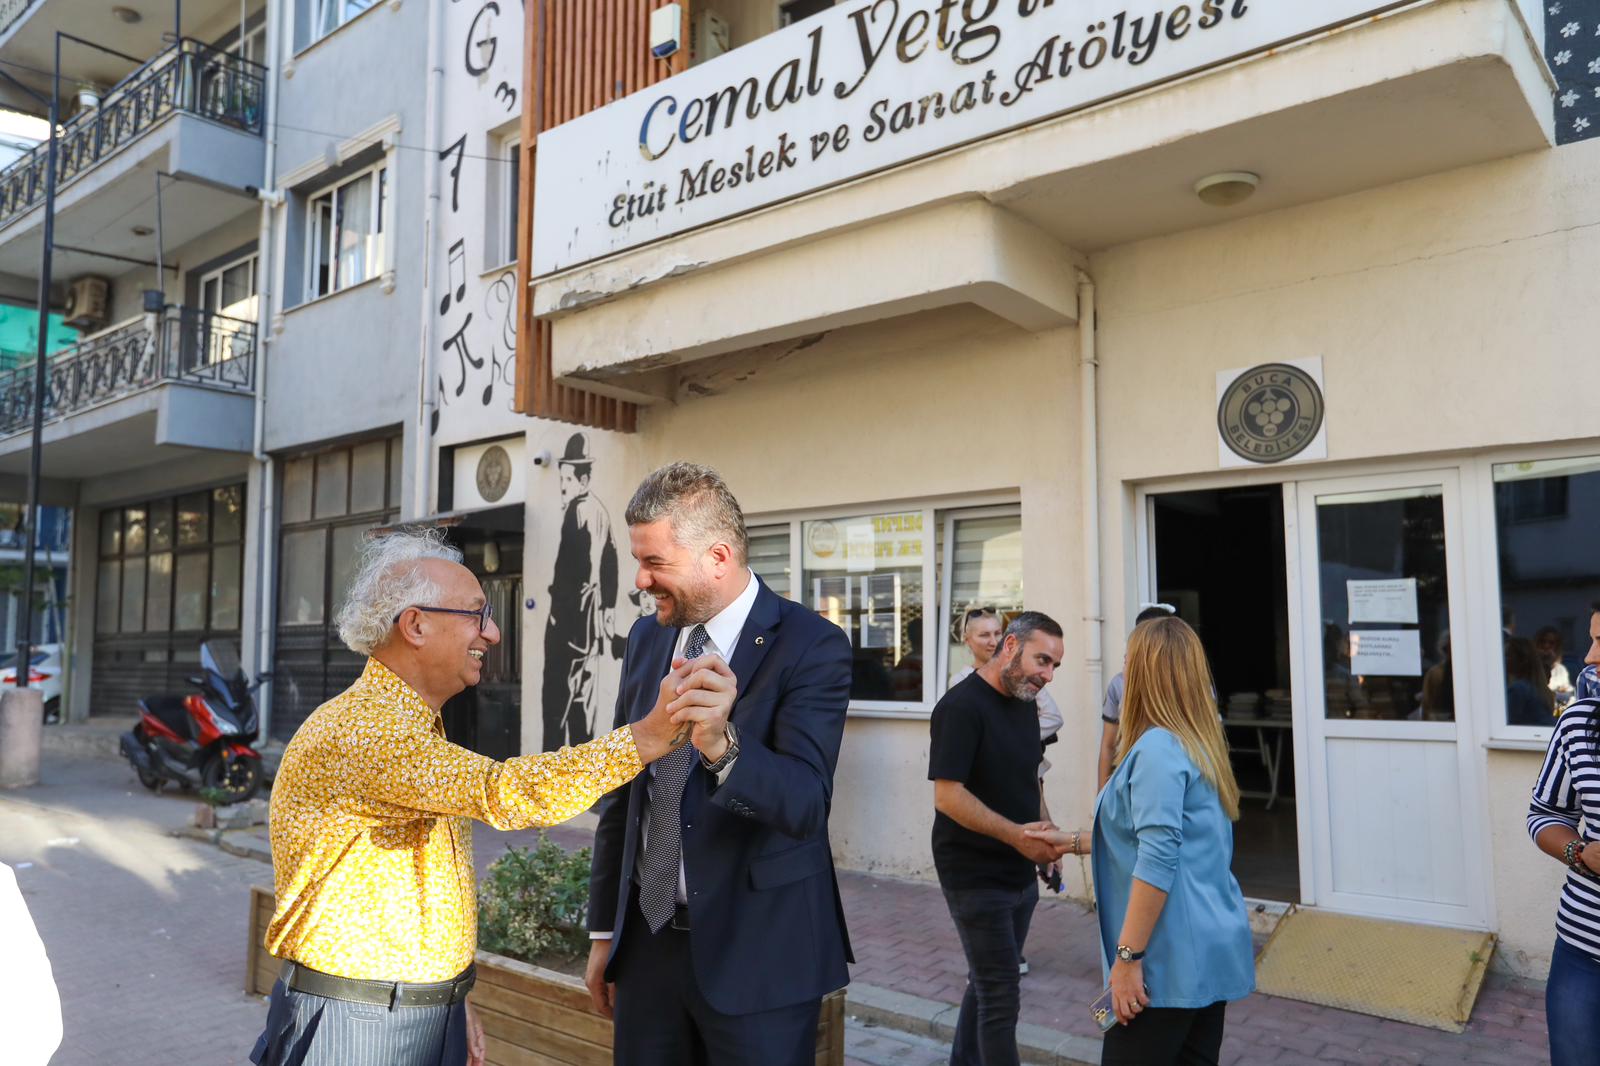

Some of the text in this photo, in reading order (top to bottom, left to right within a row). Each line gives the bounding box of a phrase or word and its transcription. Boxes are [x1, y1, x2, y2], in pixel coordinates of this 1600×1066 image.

[608, 181, 668, 228] Etüt
[675, 132, 797, 205] Meslek
[810, 123, 850, 162] ve
[863, 69, 997, 142] Sanat
[638, 0, 1053, 161] Cemal Yetg
[1241, 373, 1292, 394] BUCA
